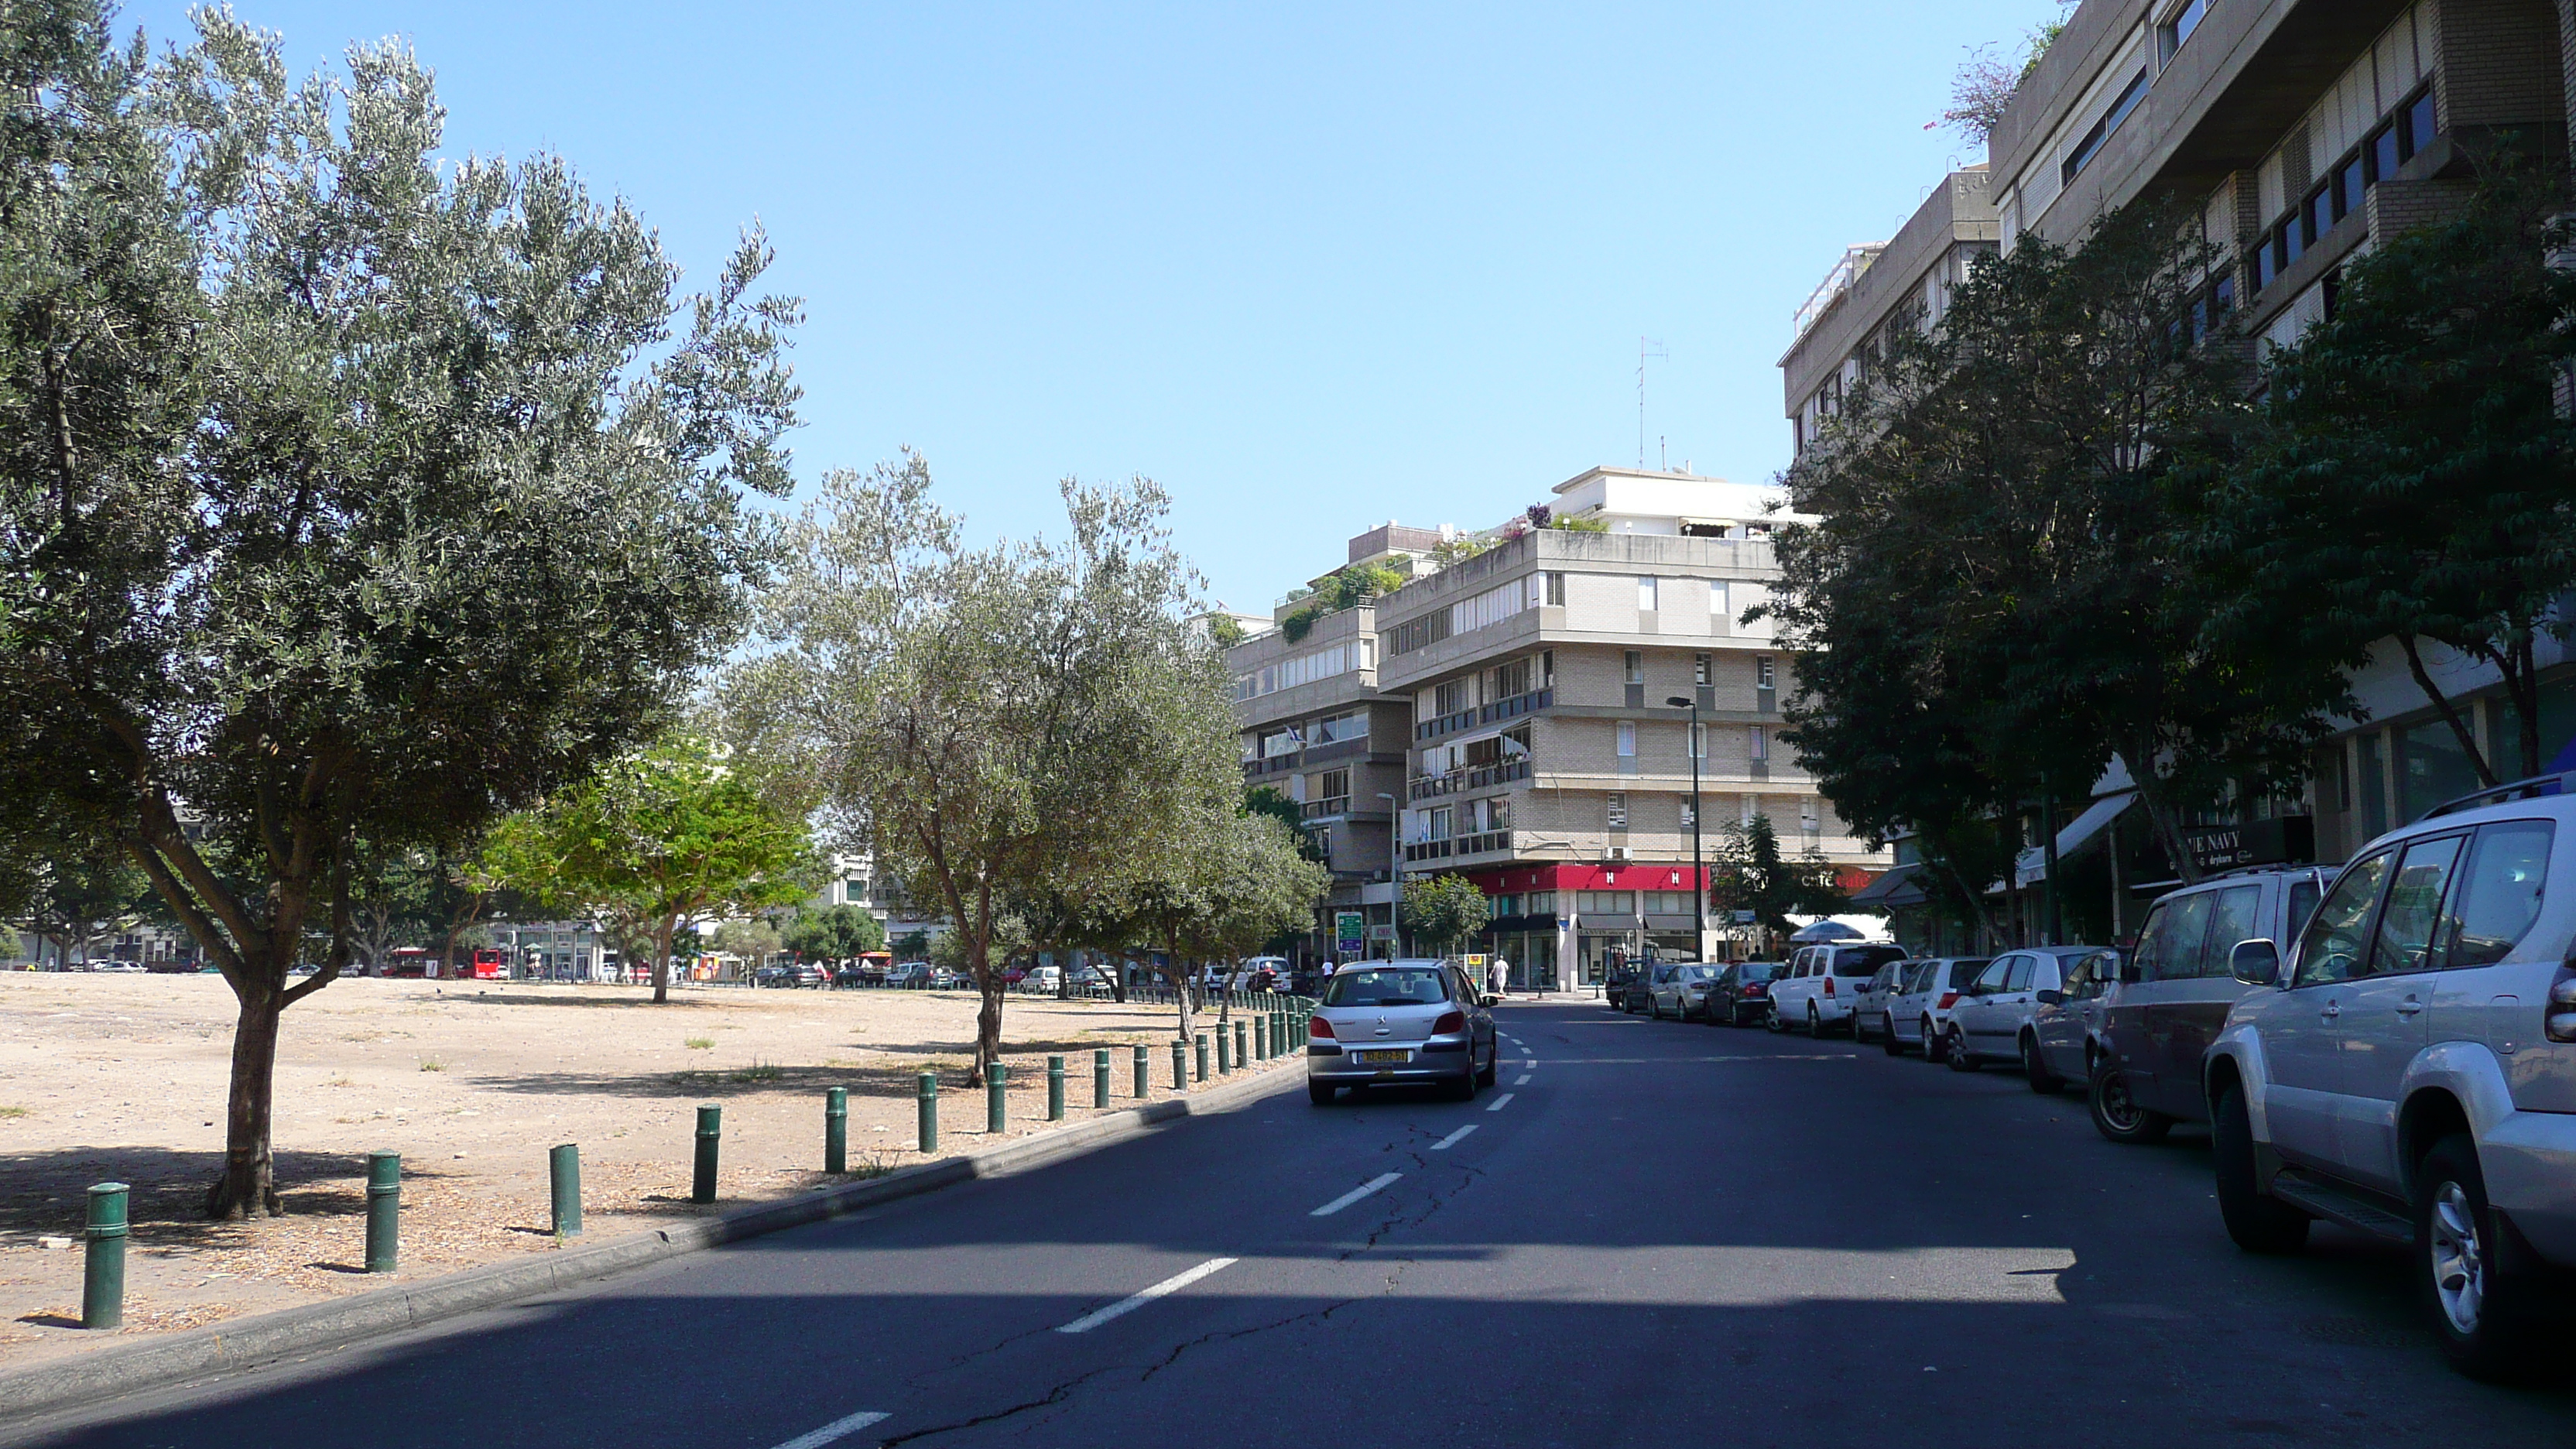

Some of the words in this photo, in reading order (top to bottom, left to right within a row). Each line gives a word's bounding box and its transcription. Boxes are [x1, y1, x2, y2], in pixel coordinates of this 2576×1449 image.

[2187, 837, 2204, 853] UE
[2208, 831, 2240, 851] NAVY
[1606, 872, 1614, 884] H
[1672, 872, 1680, 884] H
[1836, 872, 1869, 888] café
